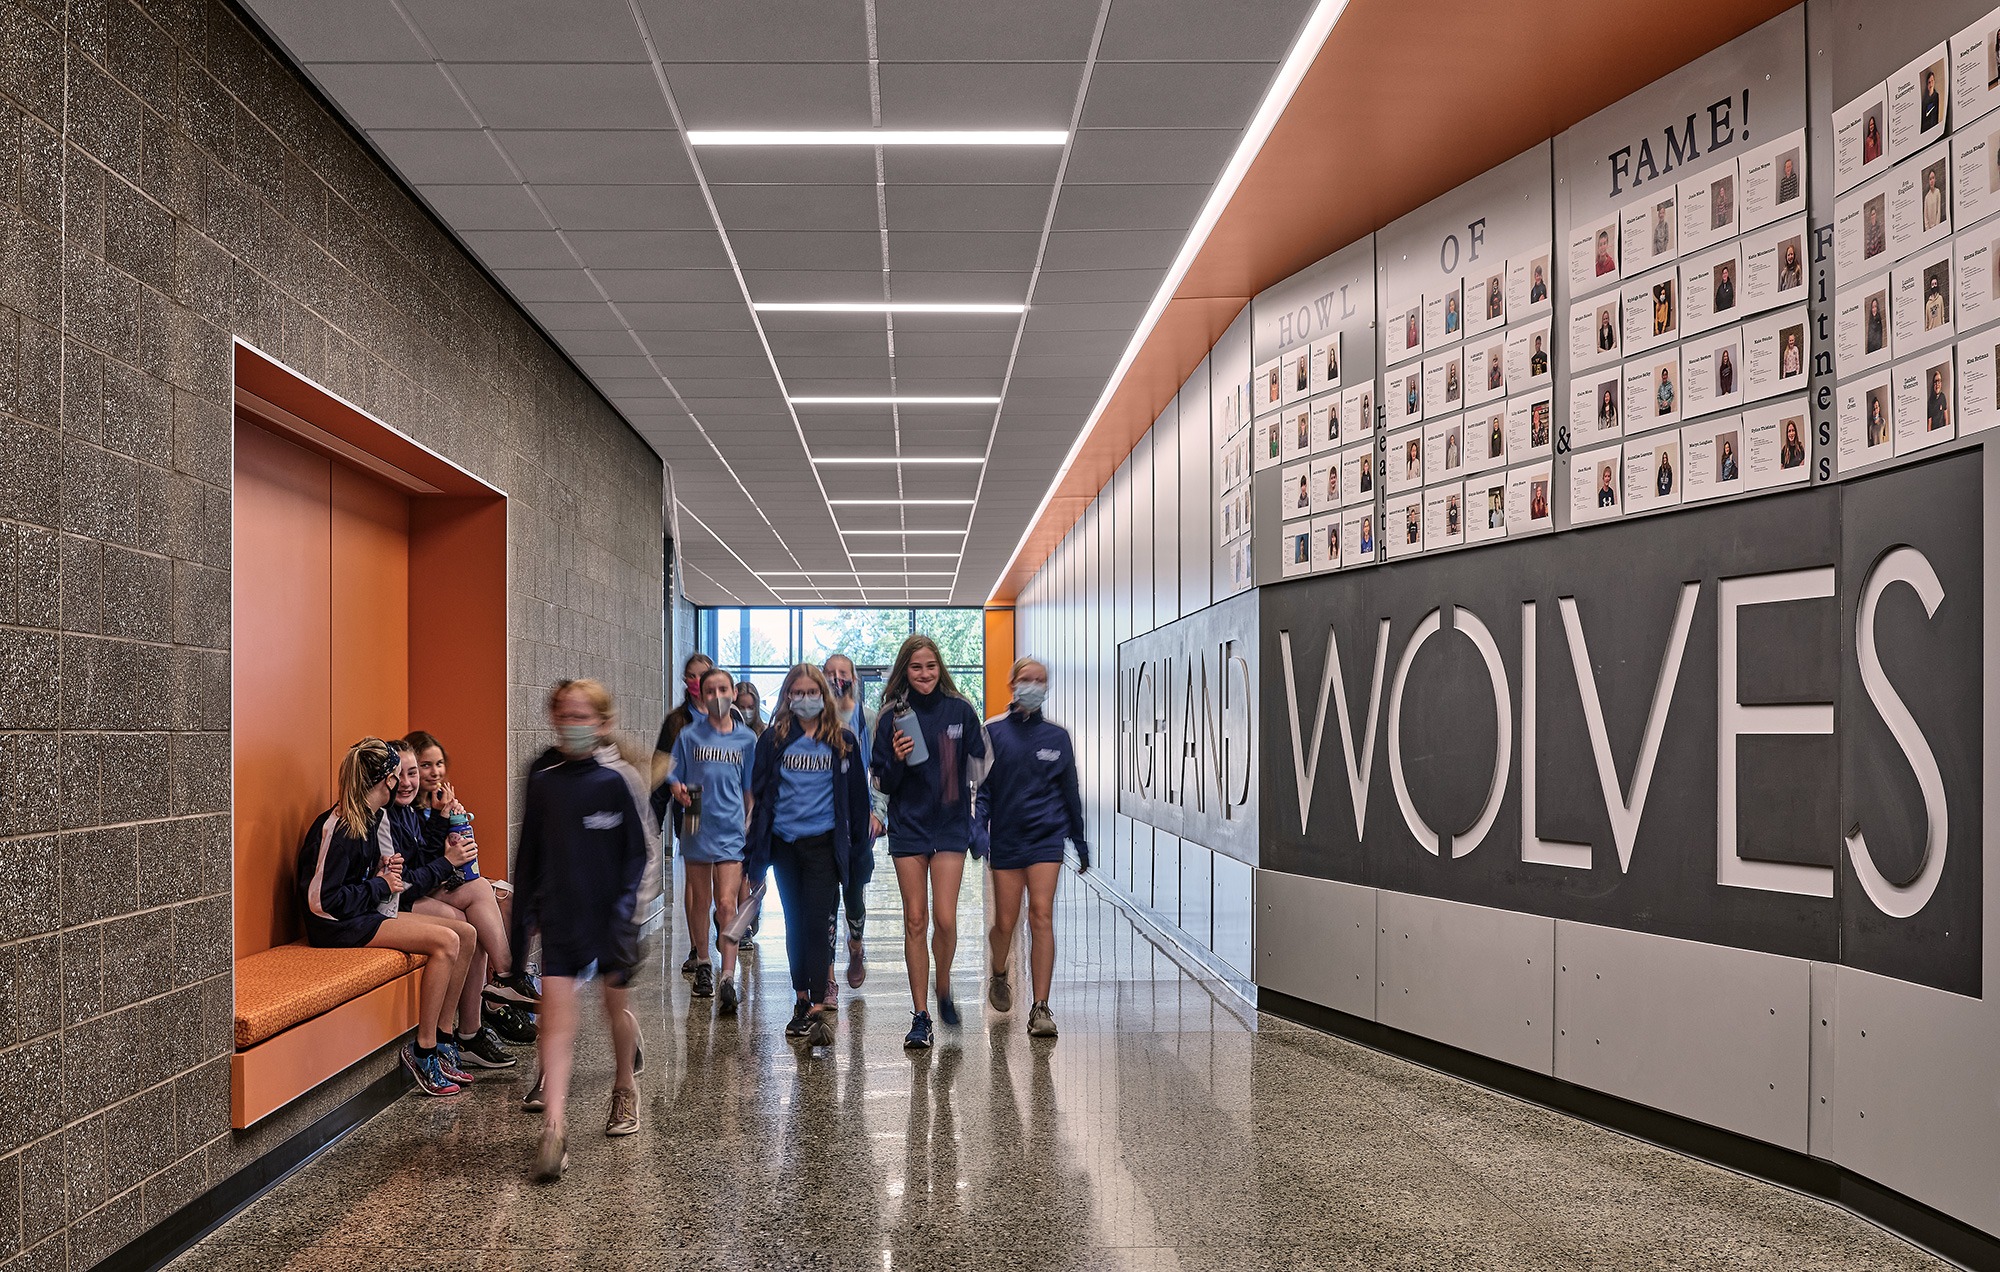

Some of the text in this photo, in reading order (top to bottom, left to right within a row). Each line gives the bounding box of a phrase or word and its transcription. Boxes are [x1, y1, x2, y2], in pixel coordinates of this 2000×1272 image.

[1278, 88, 1749, 349] HOWL OF FAME!
[1376, 404, 1388, 563] Health
[1556, 425, 1572, 455] &
[1814, 228, 1834, 482] Fitness
[782, 754, 832, 771] HIGHLAN
[1120, 543, 1949, 918] HIGHLAND WOLVES
